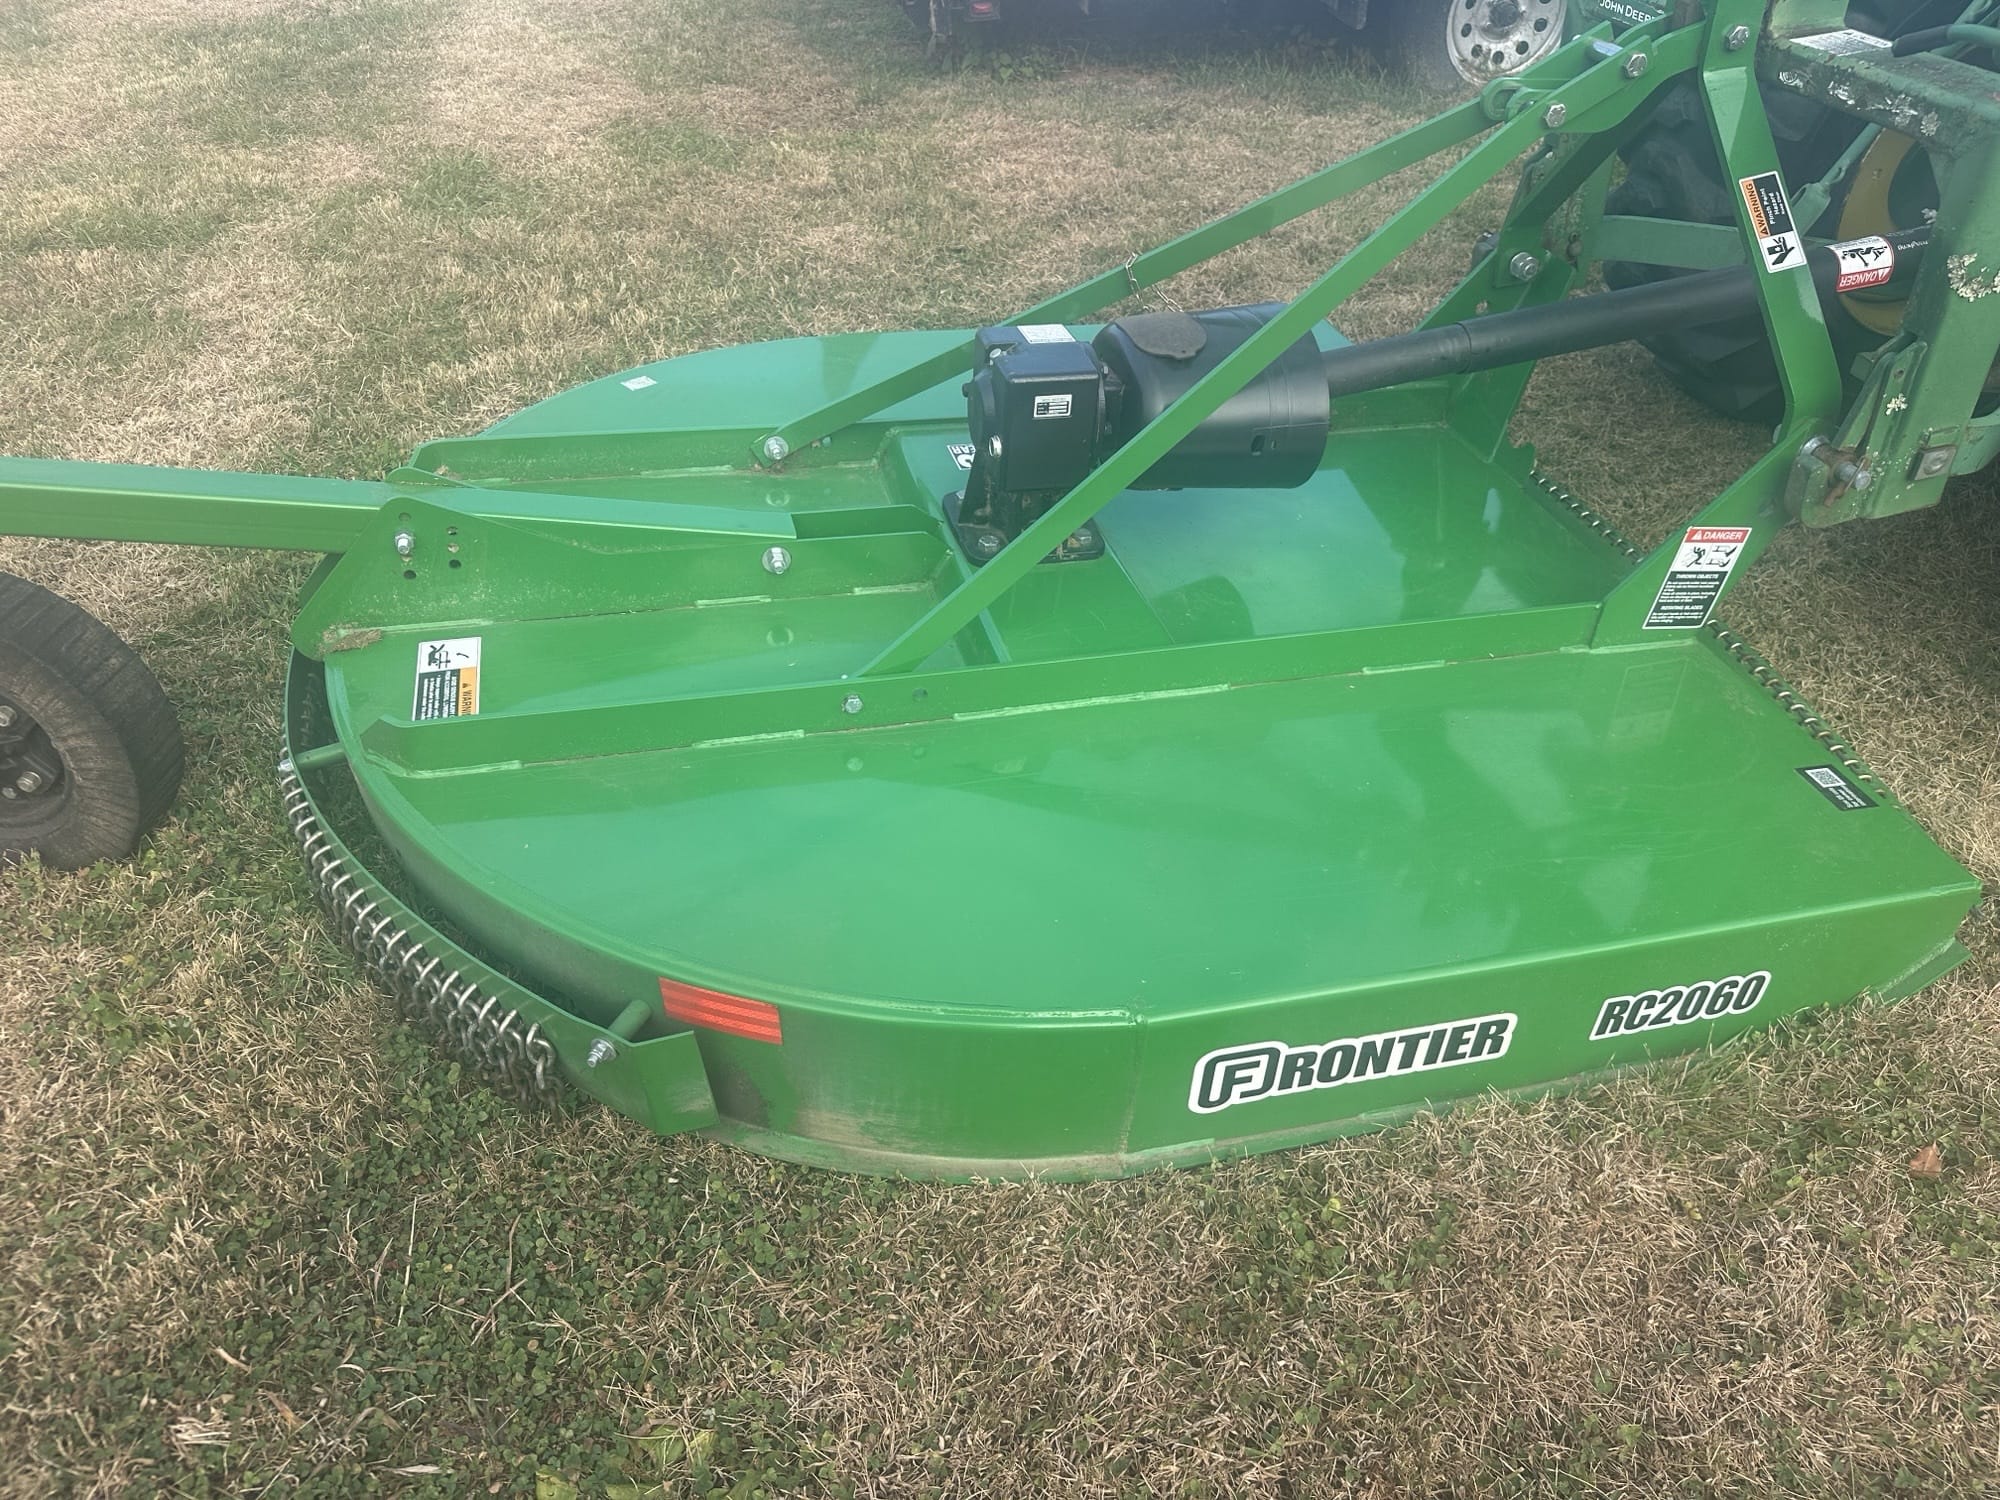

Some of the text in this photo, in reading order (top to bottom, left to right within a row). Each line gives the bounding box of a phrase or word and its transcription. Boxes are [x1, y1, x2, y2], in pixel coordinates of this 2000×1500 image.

[1599, 0, 1656, 23] JOHN DEER
[1745, 183, 1766, 227] WARNING
[1840, 271, 1878, 287] DANGER
[1702, 531, 1743, 540] DANGER
[461, 689, 473, 716] WARNI
[1595, 974, 1768, 1037] RC2060
[1198, 1018, 1510, 1109] FRONTIER
